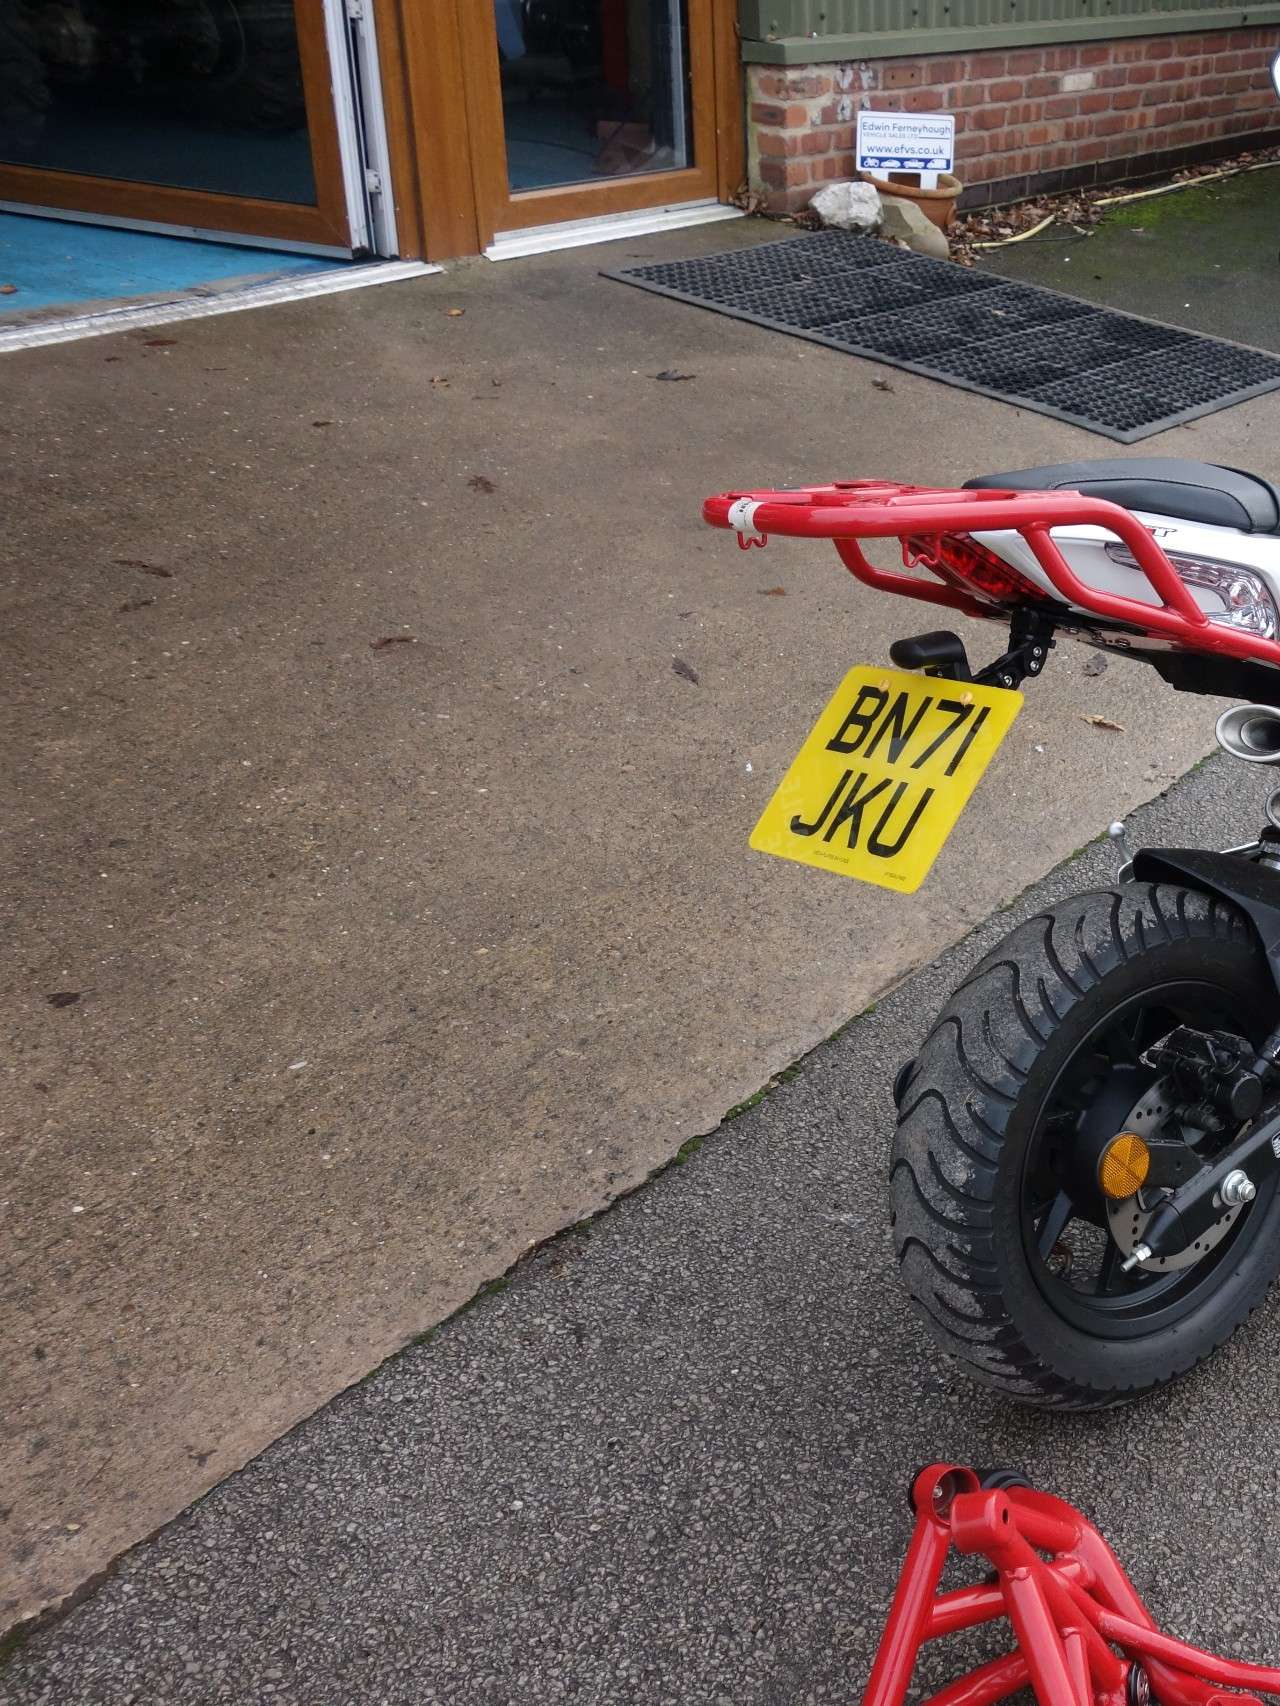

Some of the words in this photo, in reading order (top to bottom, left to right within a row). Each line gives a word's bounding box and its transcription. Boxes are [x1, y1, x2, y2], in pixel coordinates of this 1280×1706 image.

[862, 121, 890, 131] Edwin
[892, 123, 951, 135] Ferneyhough
[866, 143, 944, 155] www.efvs.co.uk
[825, 684, 991, 777] BN71
[789, 769, 935, 858] JKU
